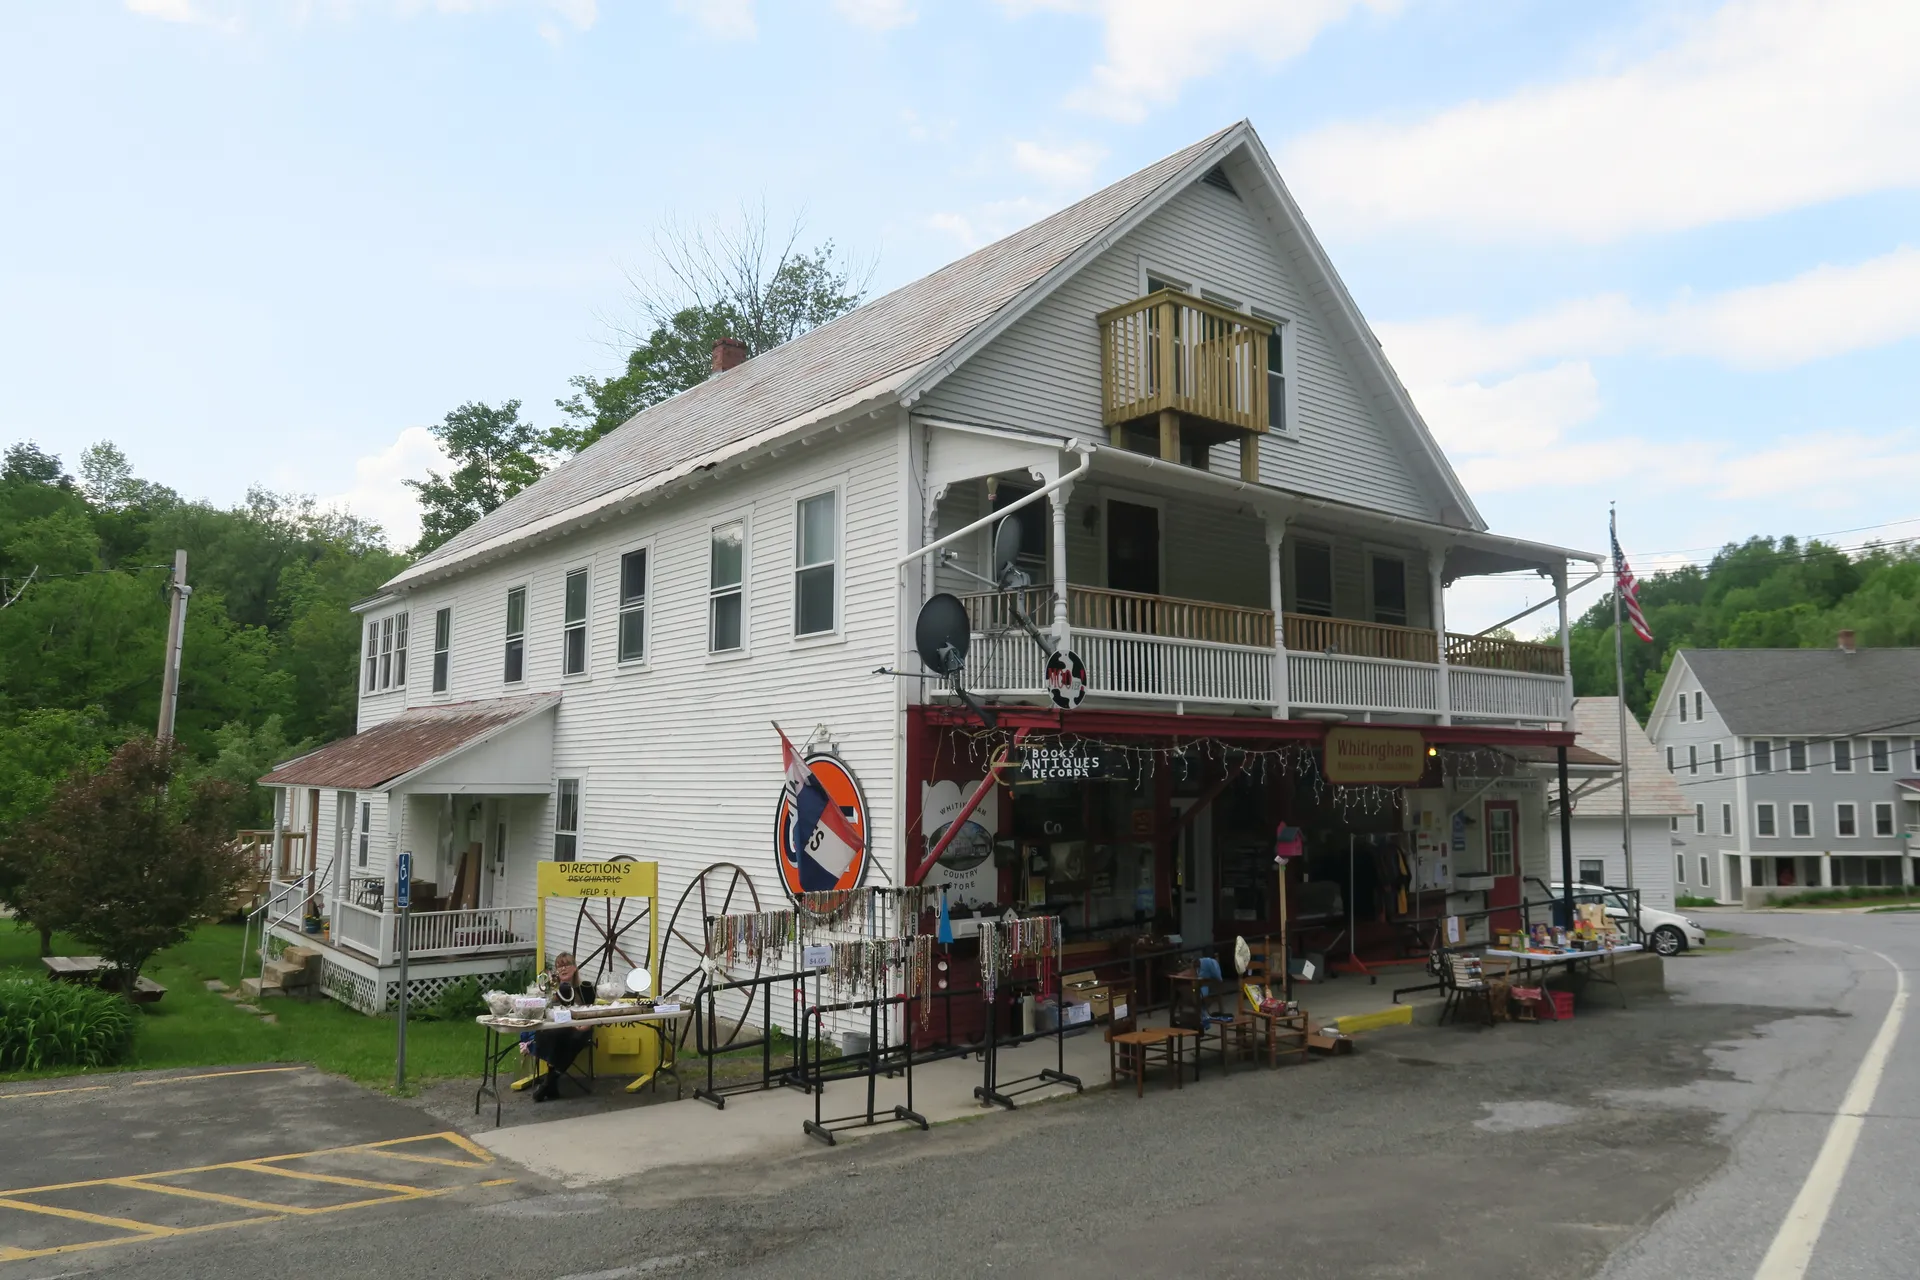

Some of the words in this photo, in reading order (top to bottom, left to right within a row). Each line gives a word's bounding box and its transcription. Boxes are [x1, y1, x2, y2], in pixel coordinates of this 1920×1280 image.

[1032, 748, 1075, 759] BOOKS
[1337, 739, 1414, 761] Whitingham
[1022, 757, 1100, 770] ANTIQUES
[1032, 768, 1088, 779] RECORDS
[559, 863, 631, 874] DIRECTIONS
[943, 867, 978, 879] COUNTRY
[580, 888, 600, 896] HELP
[603, 888, 609, 896] 5
